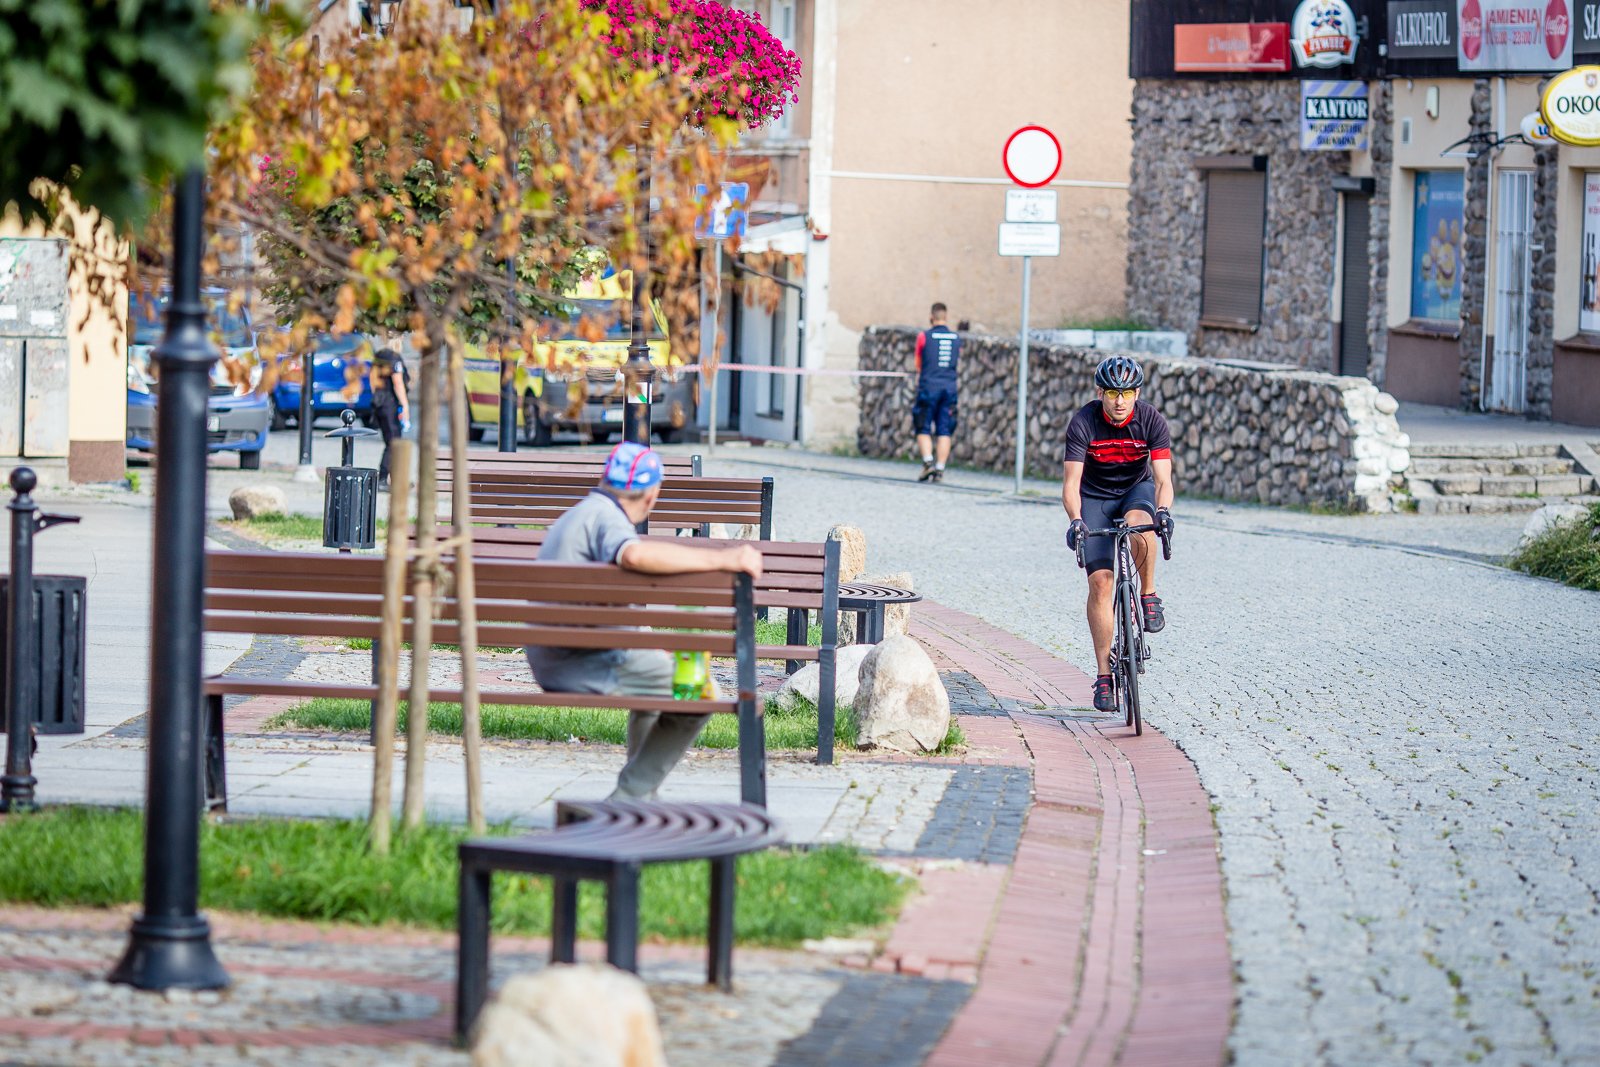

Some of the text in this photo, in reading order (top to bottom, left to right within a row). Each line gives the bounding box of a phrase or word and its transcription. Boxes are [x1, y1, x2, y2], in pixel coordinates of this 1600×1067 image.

[1395, 12, 1450, 46] ALKOHOL
[1583, 4, 1600, 40] SŁ
[1306, 98, 1367, 118] KANTOR
